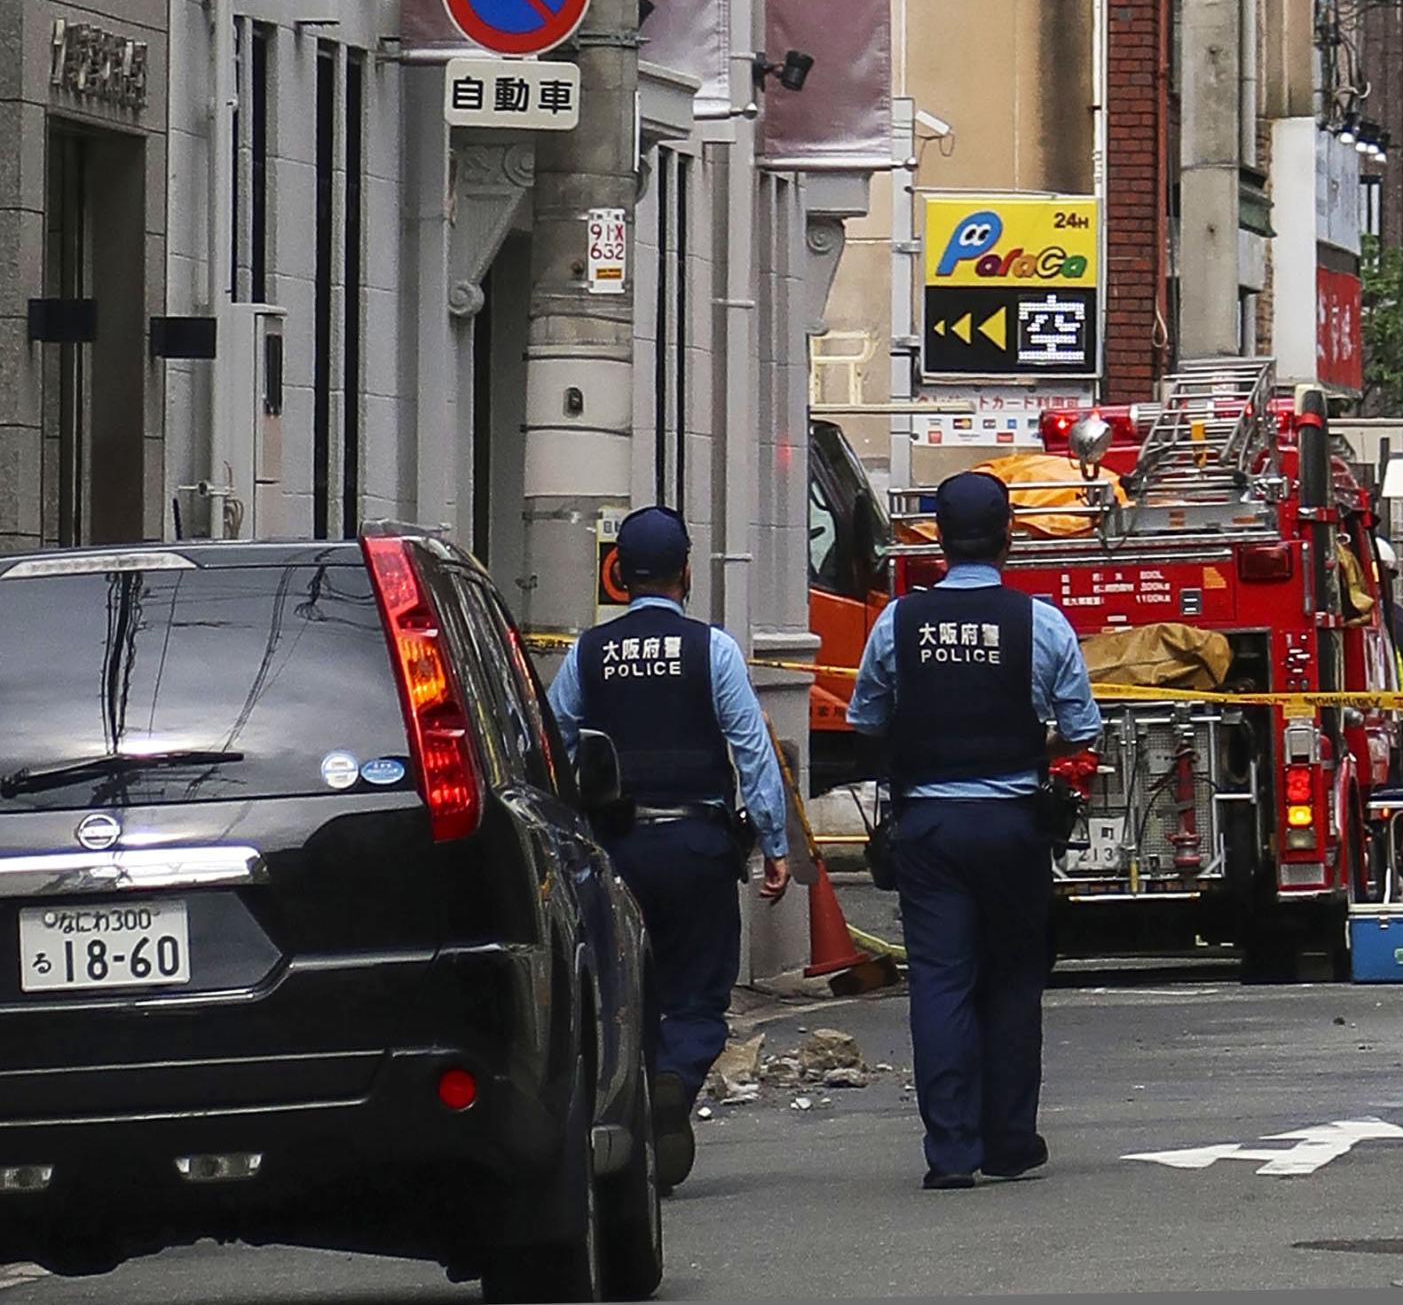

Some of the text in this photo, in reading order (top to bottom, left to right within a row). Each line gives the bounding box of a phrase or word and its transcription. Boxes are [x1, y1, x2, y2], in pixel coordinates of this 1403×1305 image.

[451, 76, 574, 115] 自動車
[1053, 212, 1089, 229] 24H
[1018, 294, 1086, 361] 空
[918, 622, 1000, 648] 大阪府警
[602, 636, 683, 665] 大阪府警
[920, 648, 1001, 665] POLICE
[604, 661, 682, 681] POLICE
[59, 909, 152, 934] なにわ 300
[64, 934, 180, 982] 18-60
